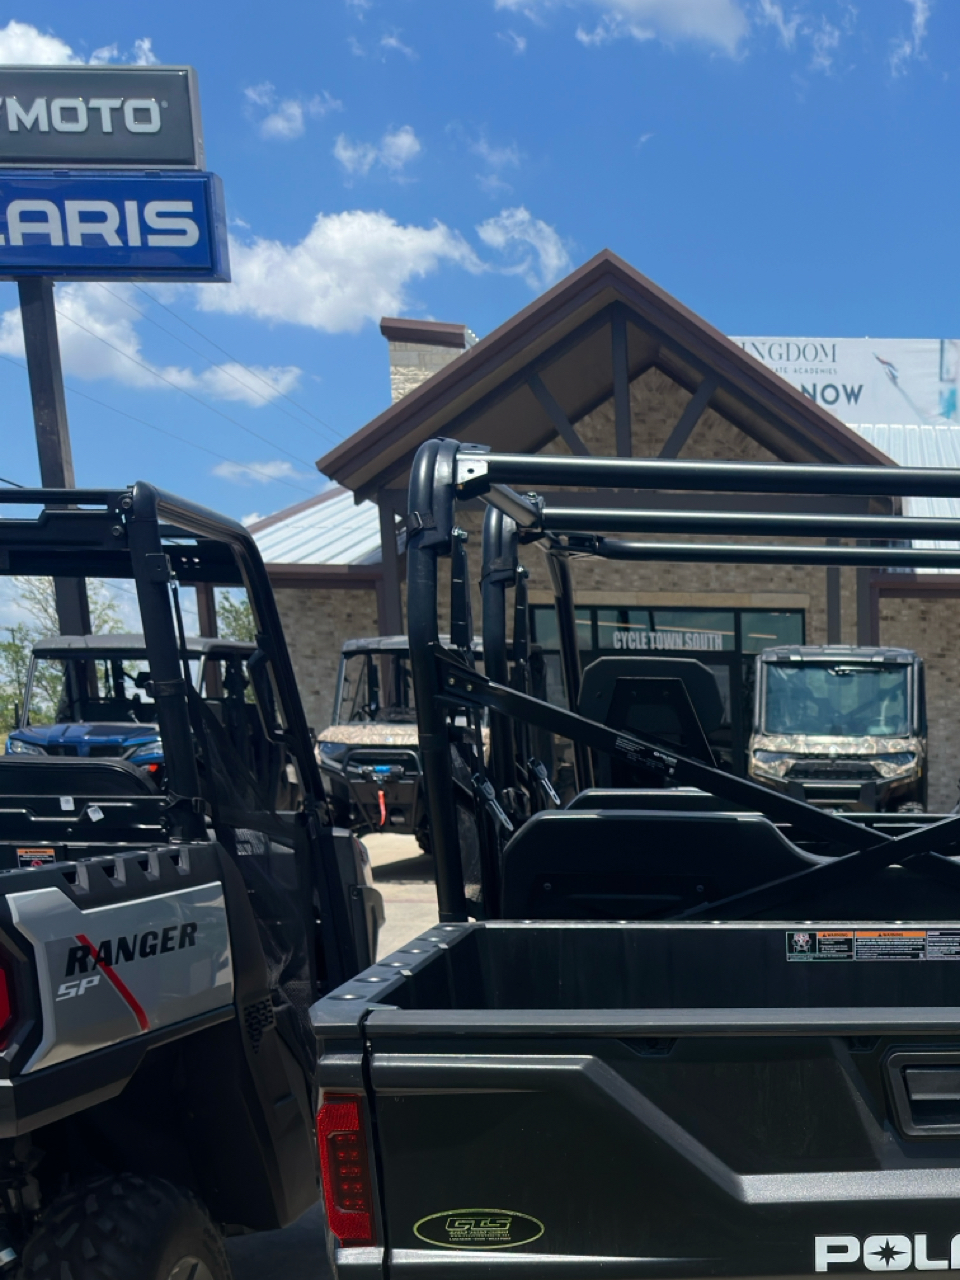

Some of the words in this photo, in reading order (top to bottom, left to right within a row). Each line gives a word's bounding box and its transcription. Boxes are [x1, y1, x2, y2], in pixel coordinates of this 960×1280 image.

[0, 98, 161, 133] MOTO
[0, 200, 200, 247] ARIS
[794, 367, 838, 375] ACADEMIES
[801, 383, 864, 405] NOW
[613, 631, 648, 649] CYCLE
[649, 632, 683, 650] TOWN
[685, 633, 723, 651] SOUTH
[65, 922, 198, 977] RANGER
[56, 974, 100, 1001] SP
